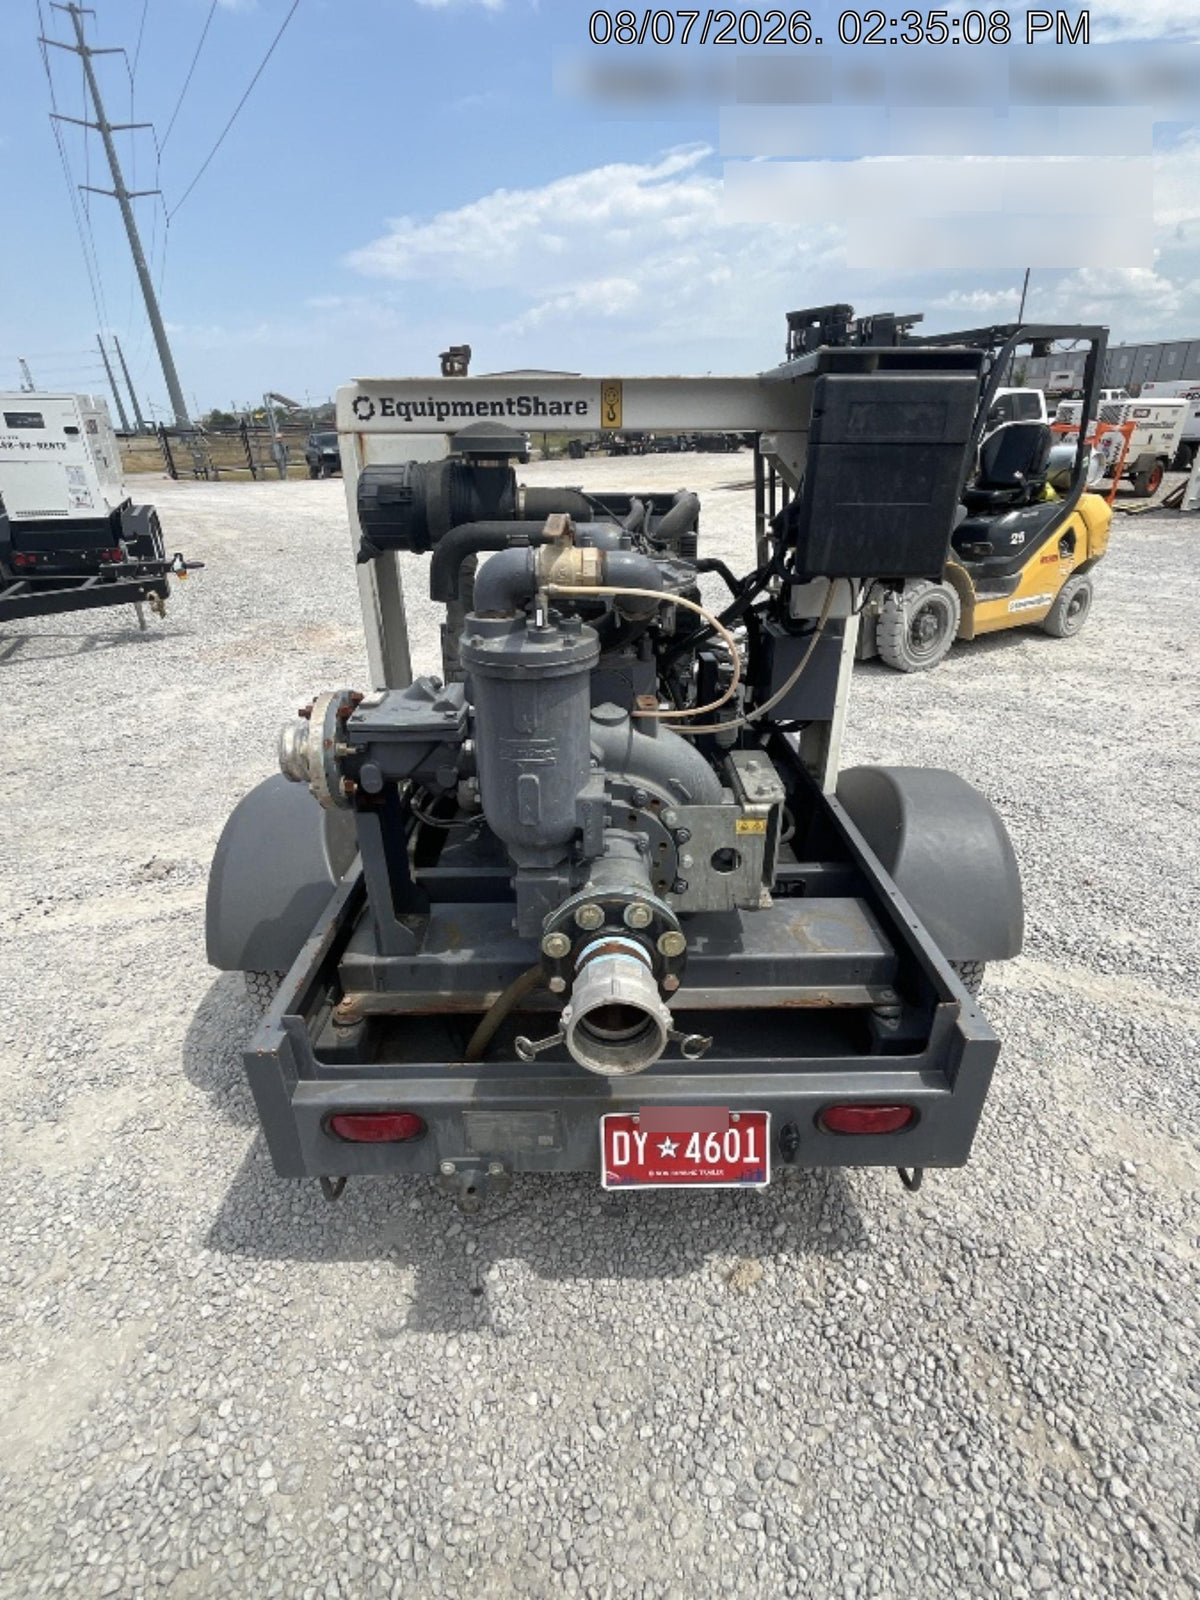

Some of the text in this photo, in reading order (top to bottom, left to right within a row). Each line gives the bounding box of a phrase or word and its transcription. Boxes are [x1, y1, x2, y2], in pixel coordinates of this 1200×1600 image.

[380, 396, 588, 421] EquipmentShare
[612, 1126, 760, 1166] DY 4601
